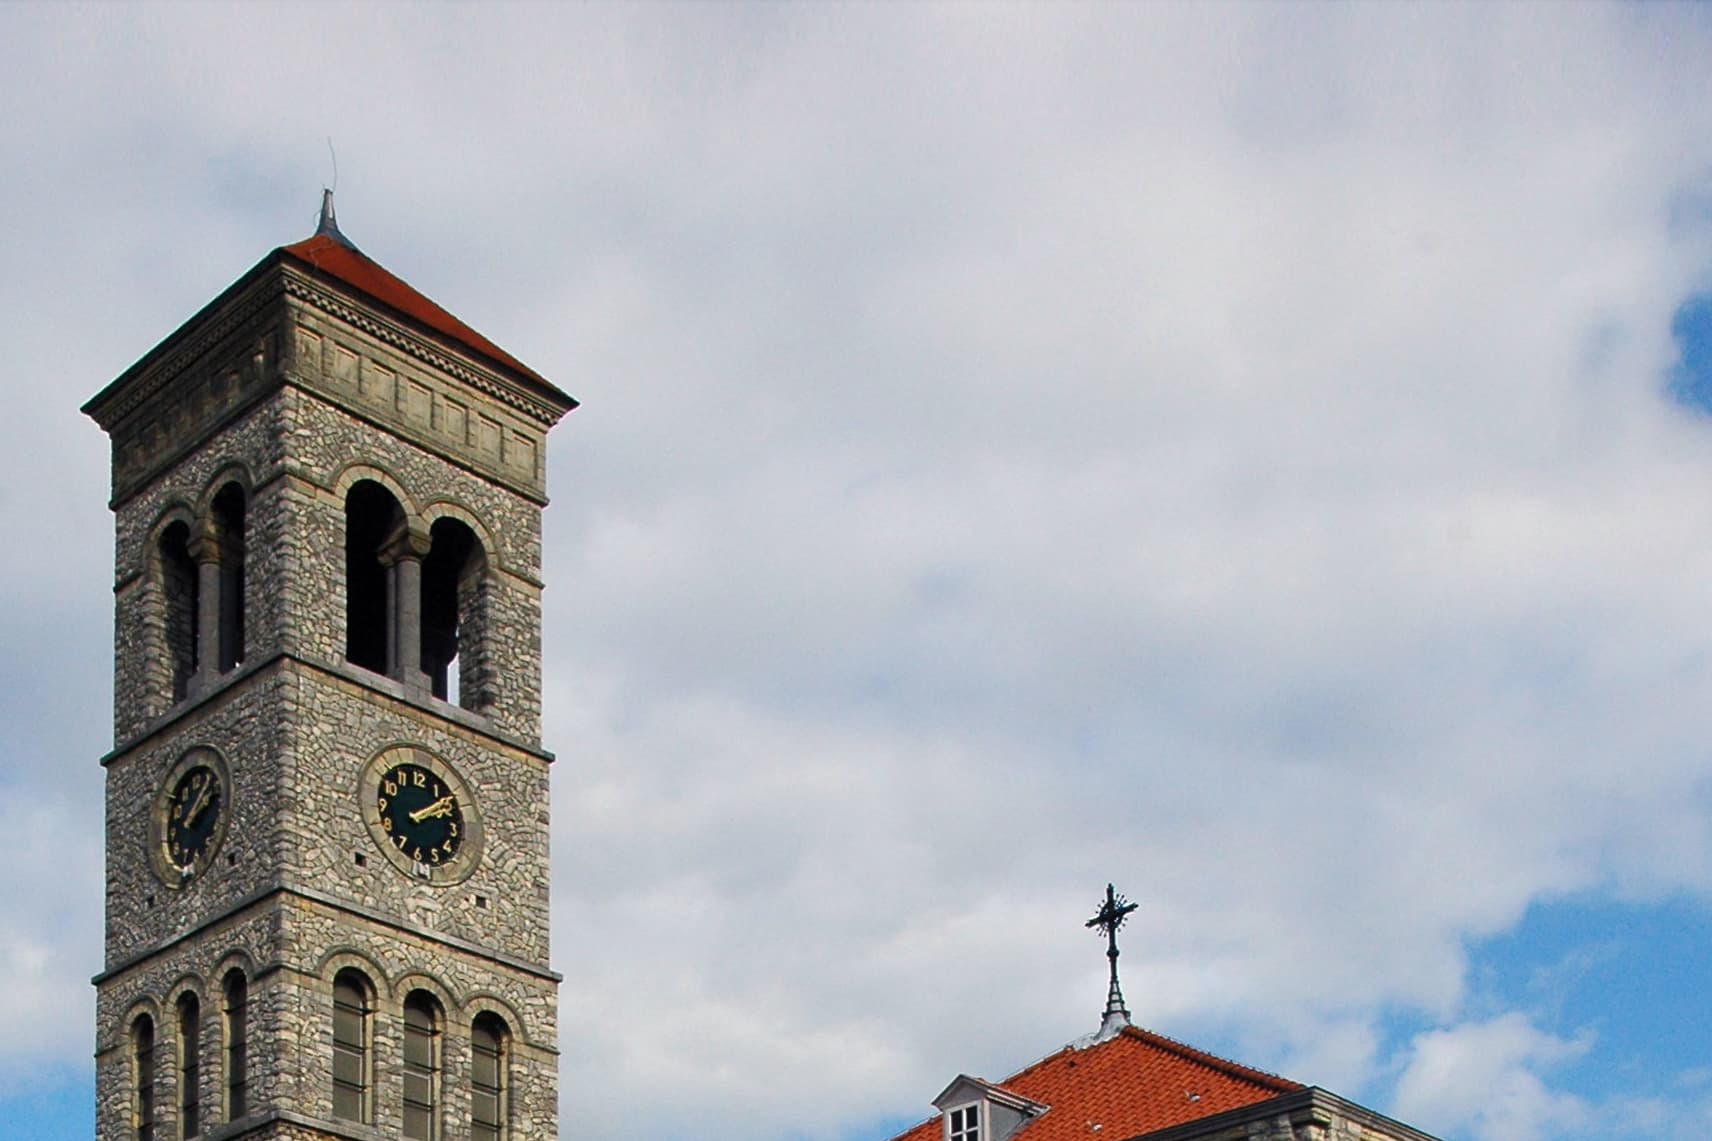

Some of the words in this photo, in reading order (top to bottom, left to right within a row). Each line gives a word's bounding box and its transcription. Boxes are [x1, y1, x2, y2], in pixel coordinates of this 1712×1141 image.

[413, 771, 426, 788] 12
[384, 780, 397, 796] 10
[450, 823, 458, 837] 3
[399, 835, 407, 849] 7
